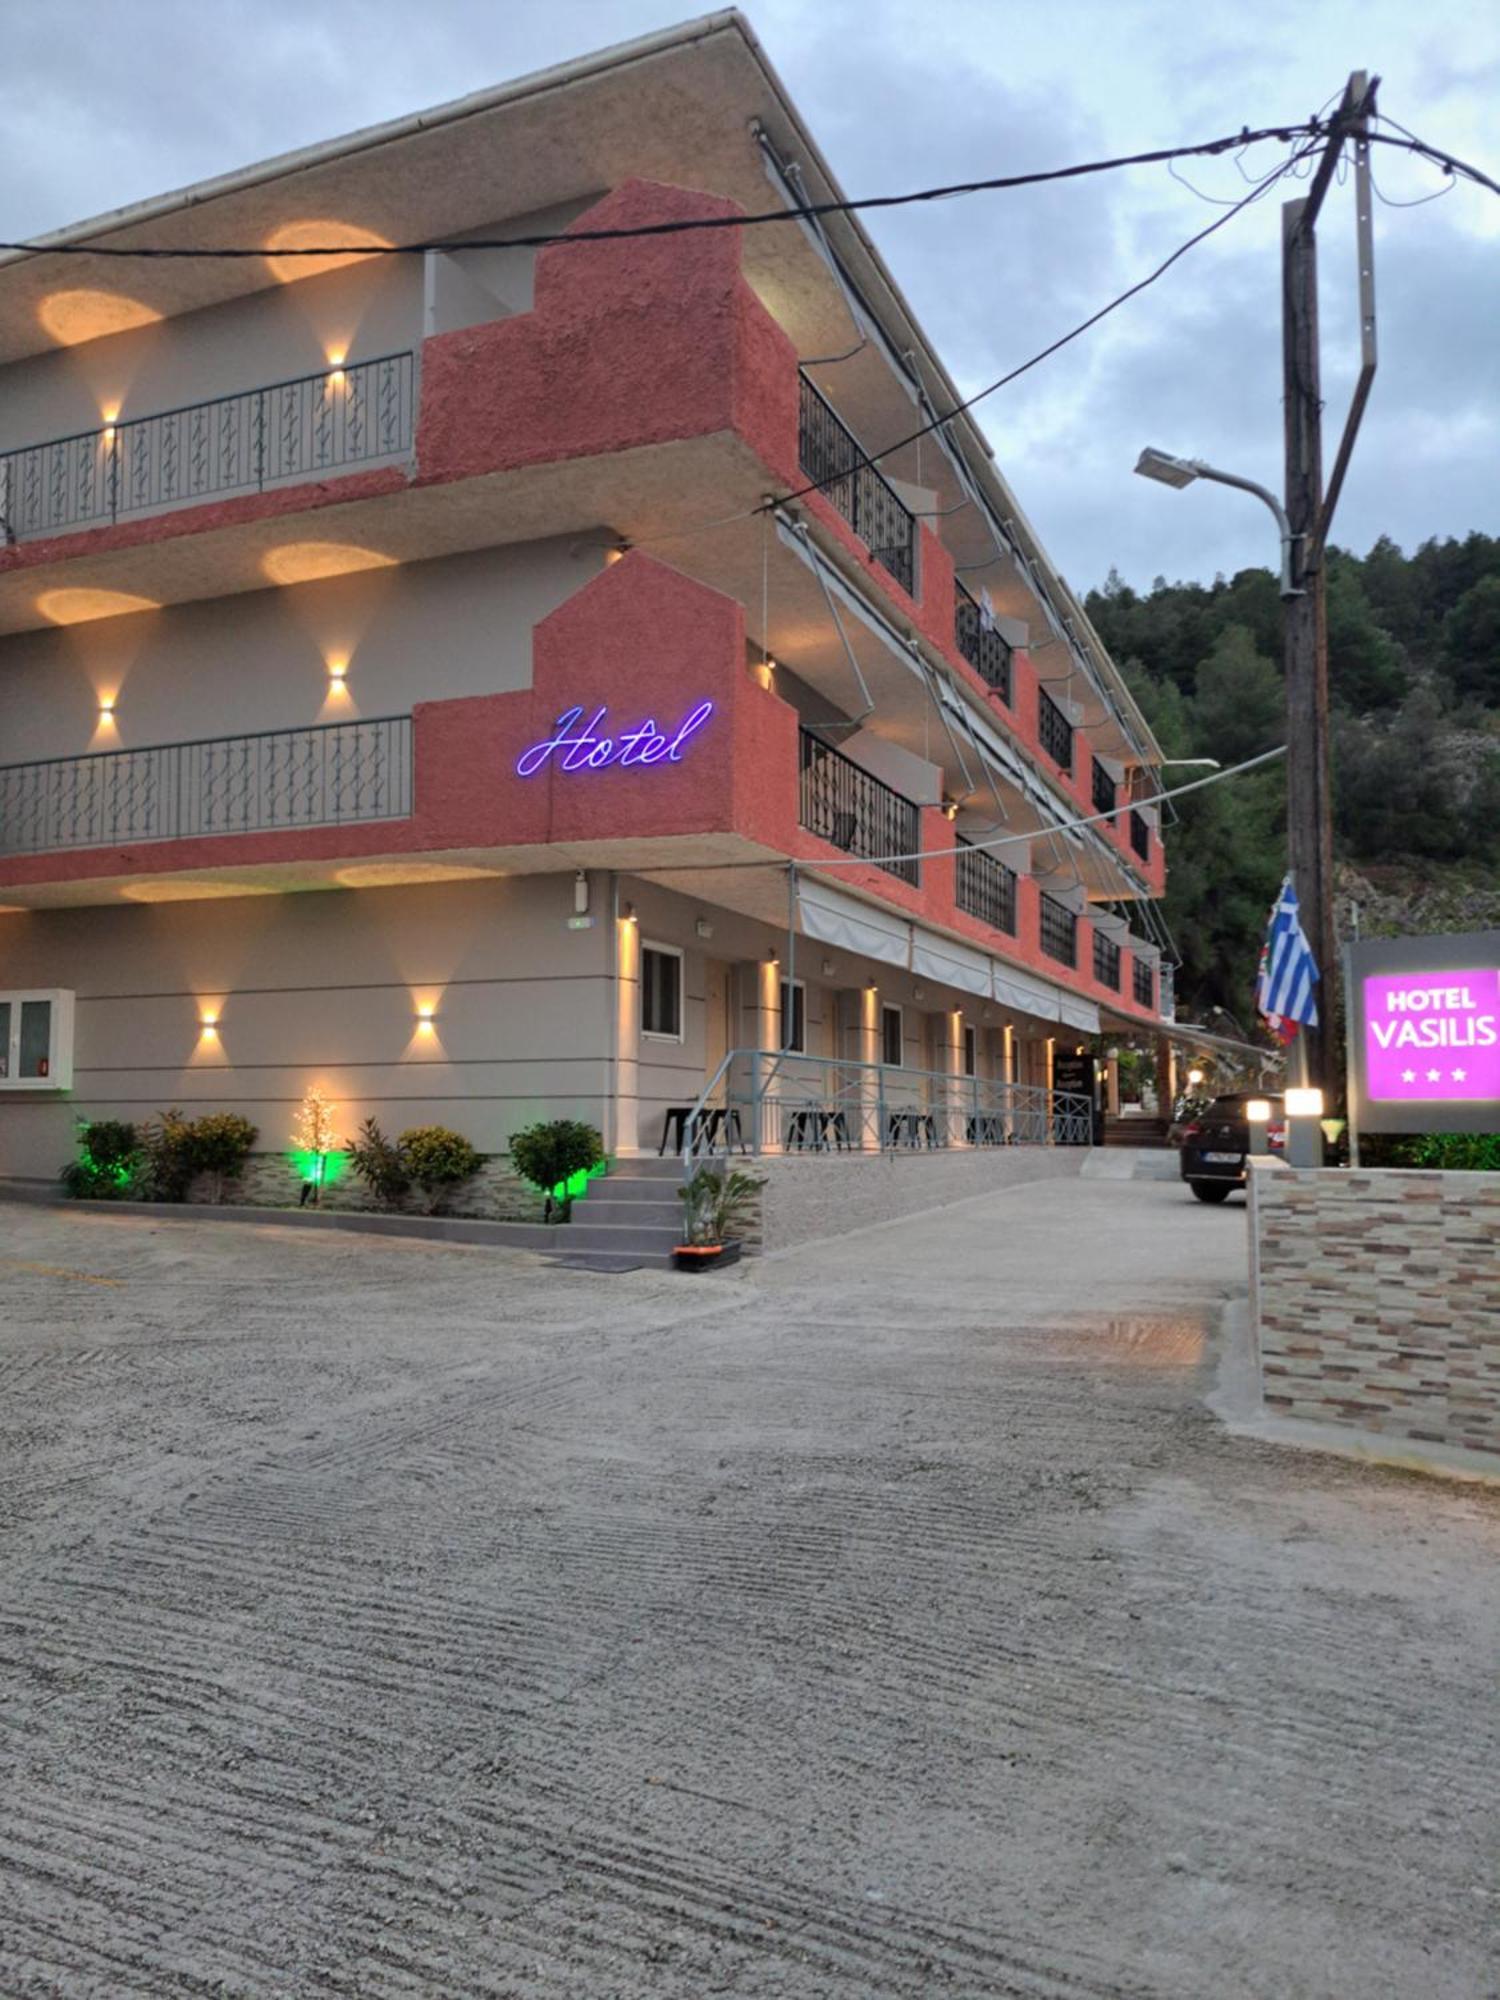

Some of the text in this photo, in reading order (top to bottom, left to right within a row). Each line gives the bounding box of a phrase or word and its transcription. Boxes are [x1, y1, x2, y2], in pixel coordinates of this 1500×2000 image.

[516, 702, 712, 776] Hotel
[1386, 987, 1476, 1012] HOTEL
[1370, 1015, 1497, 1048] VASILIS
